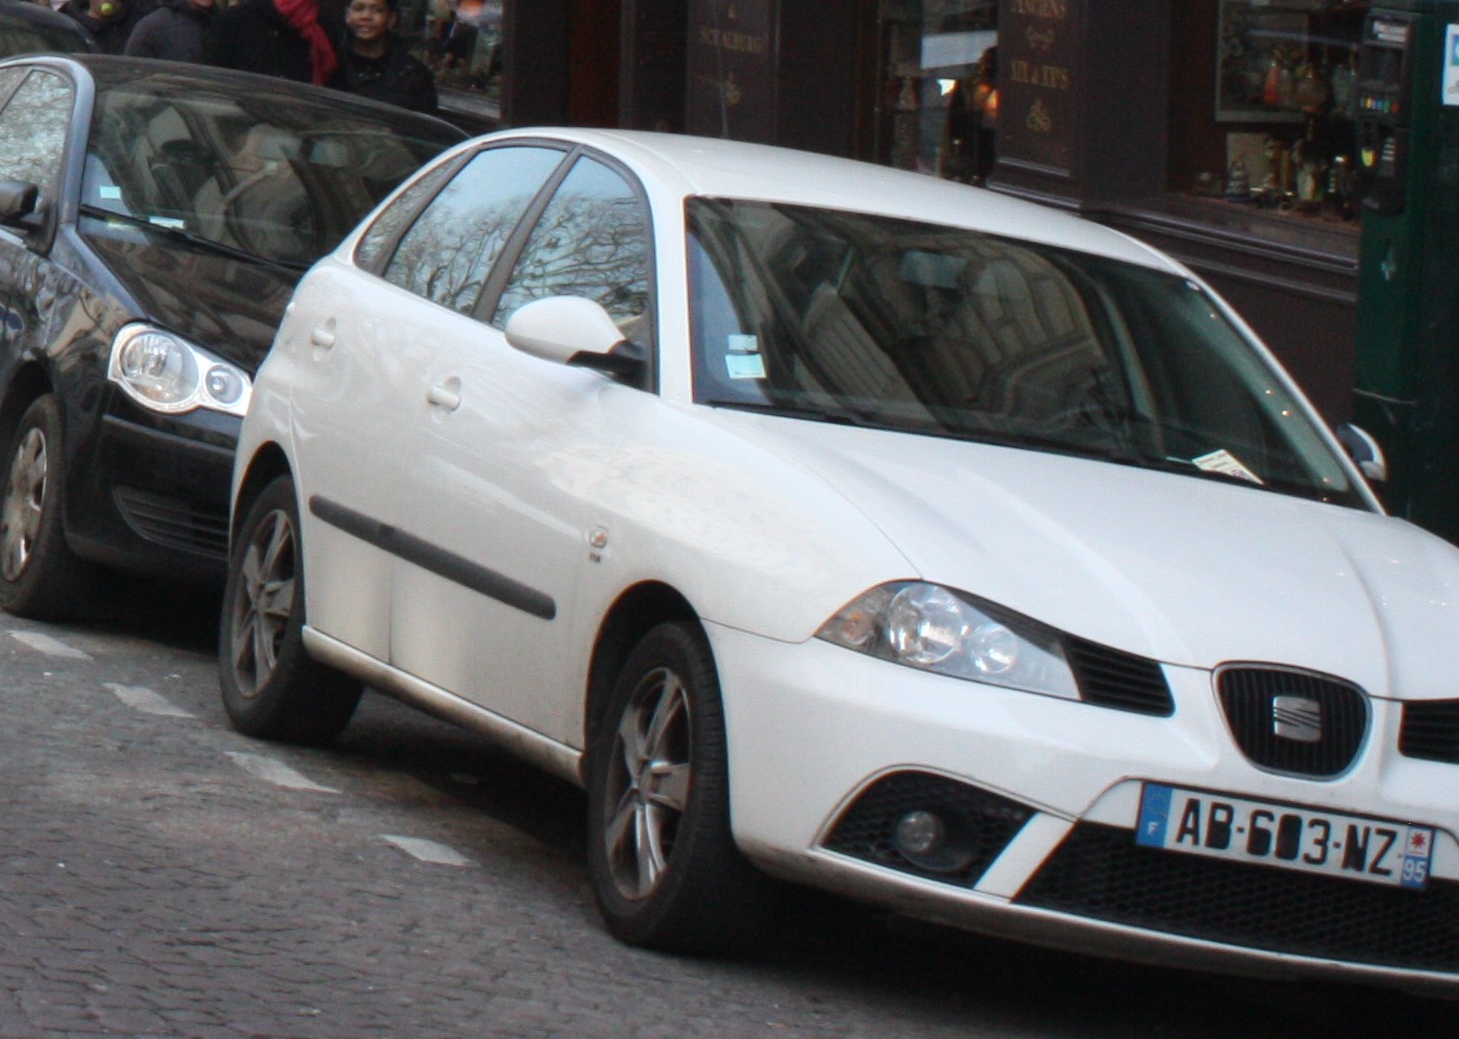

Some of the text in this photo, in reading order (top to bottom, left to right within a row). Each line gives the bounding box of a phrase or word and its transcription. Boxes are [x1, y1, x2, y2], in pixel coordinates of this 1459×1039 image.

[1147, 797, 1400, 876] F AB-603-NZ
[1403, 858, 1427, 882] 95
